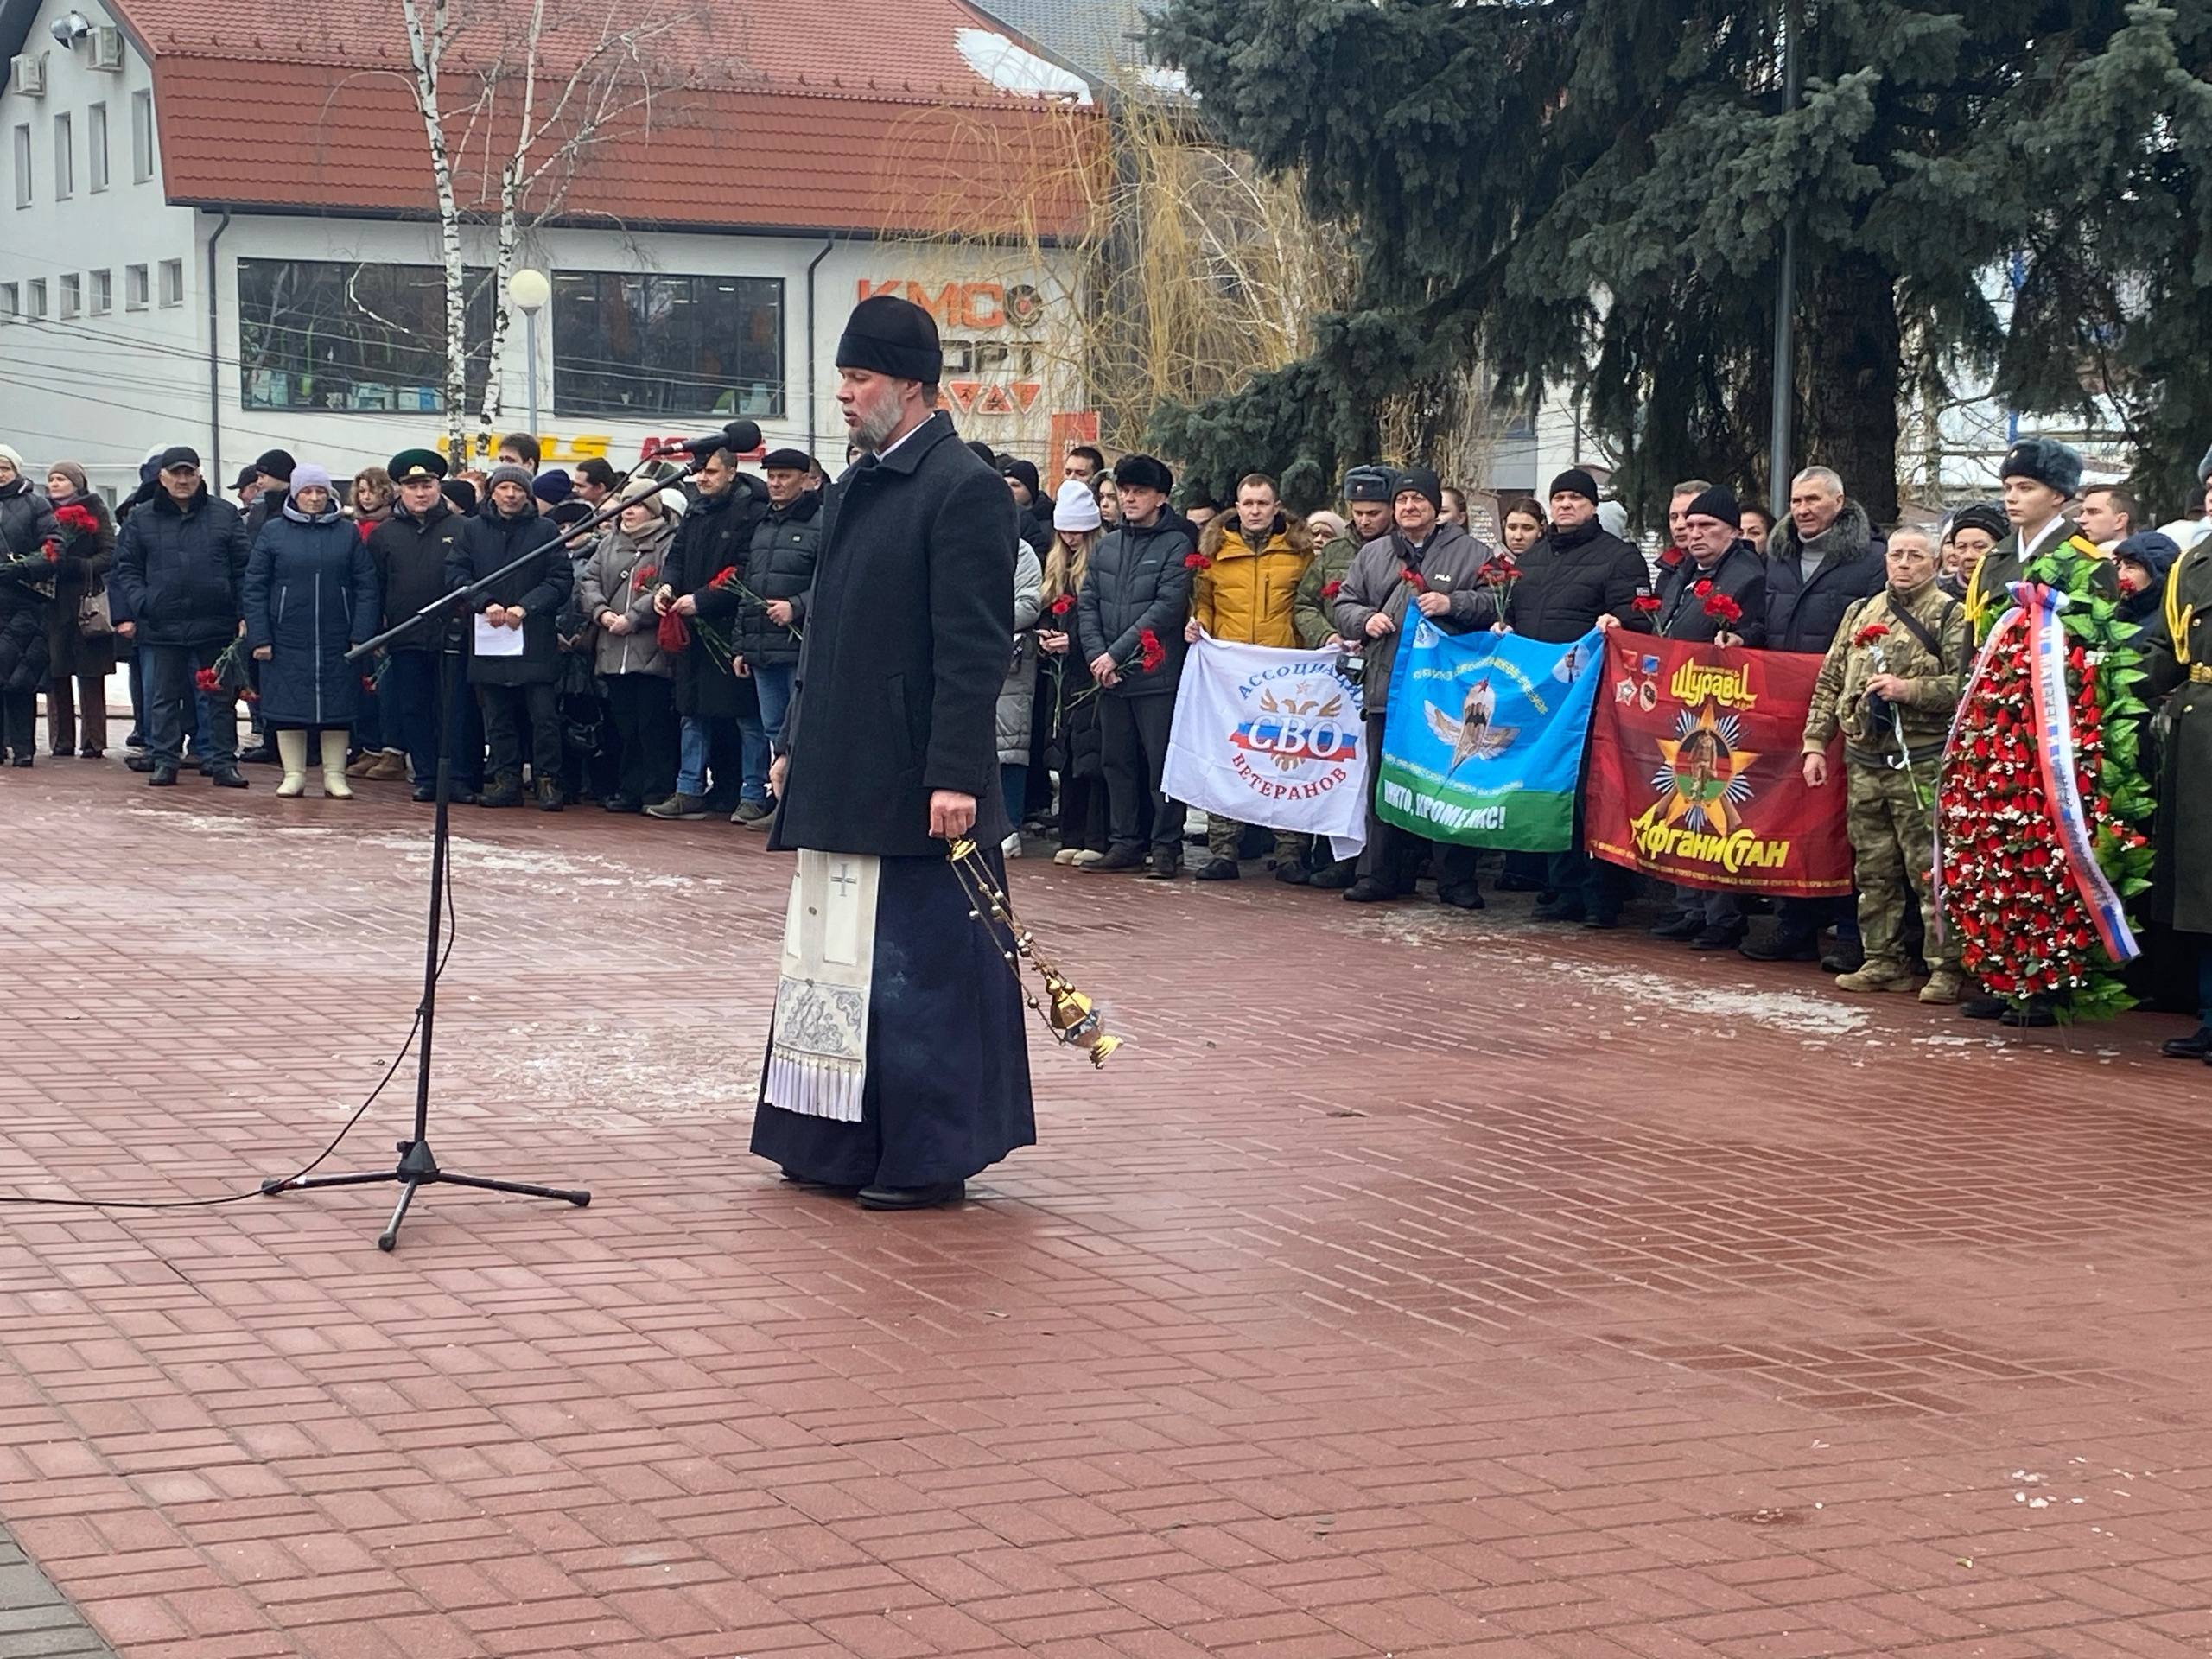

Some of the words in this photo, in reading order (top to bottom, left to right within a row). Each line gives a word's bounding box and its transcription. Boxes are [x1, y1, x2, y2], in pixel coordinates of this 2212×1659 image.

[1247, 715, 1344, 759] СВО
[1232, 753, 1348, 801] ВЕТЕРАНОВ
[1415, 793, 1471, 829] КРОМЕ
